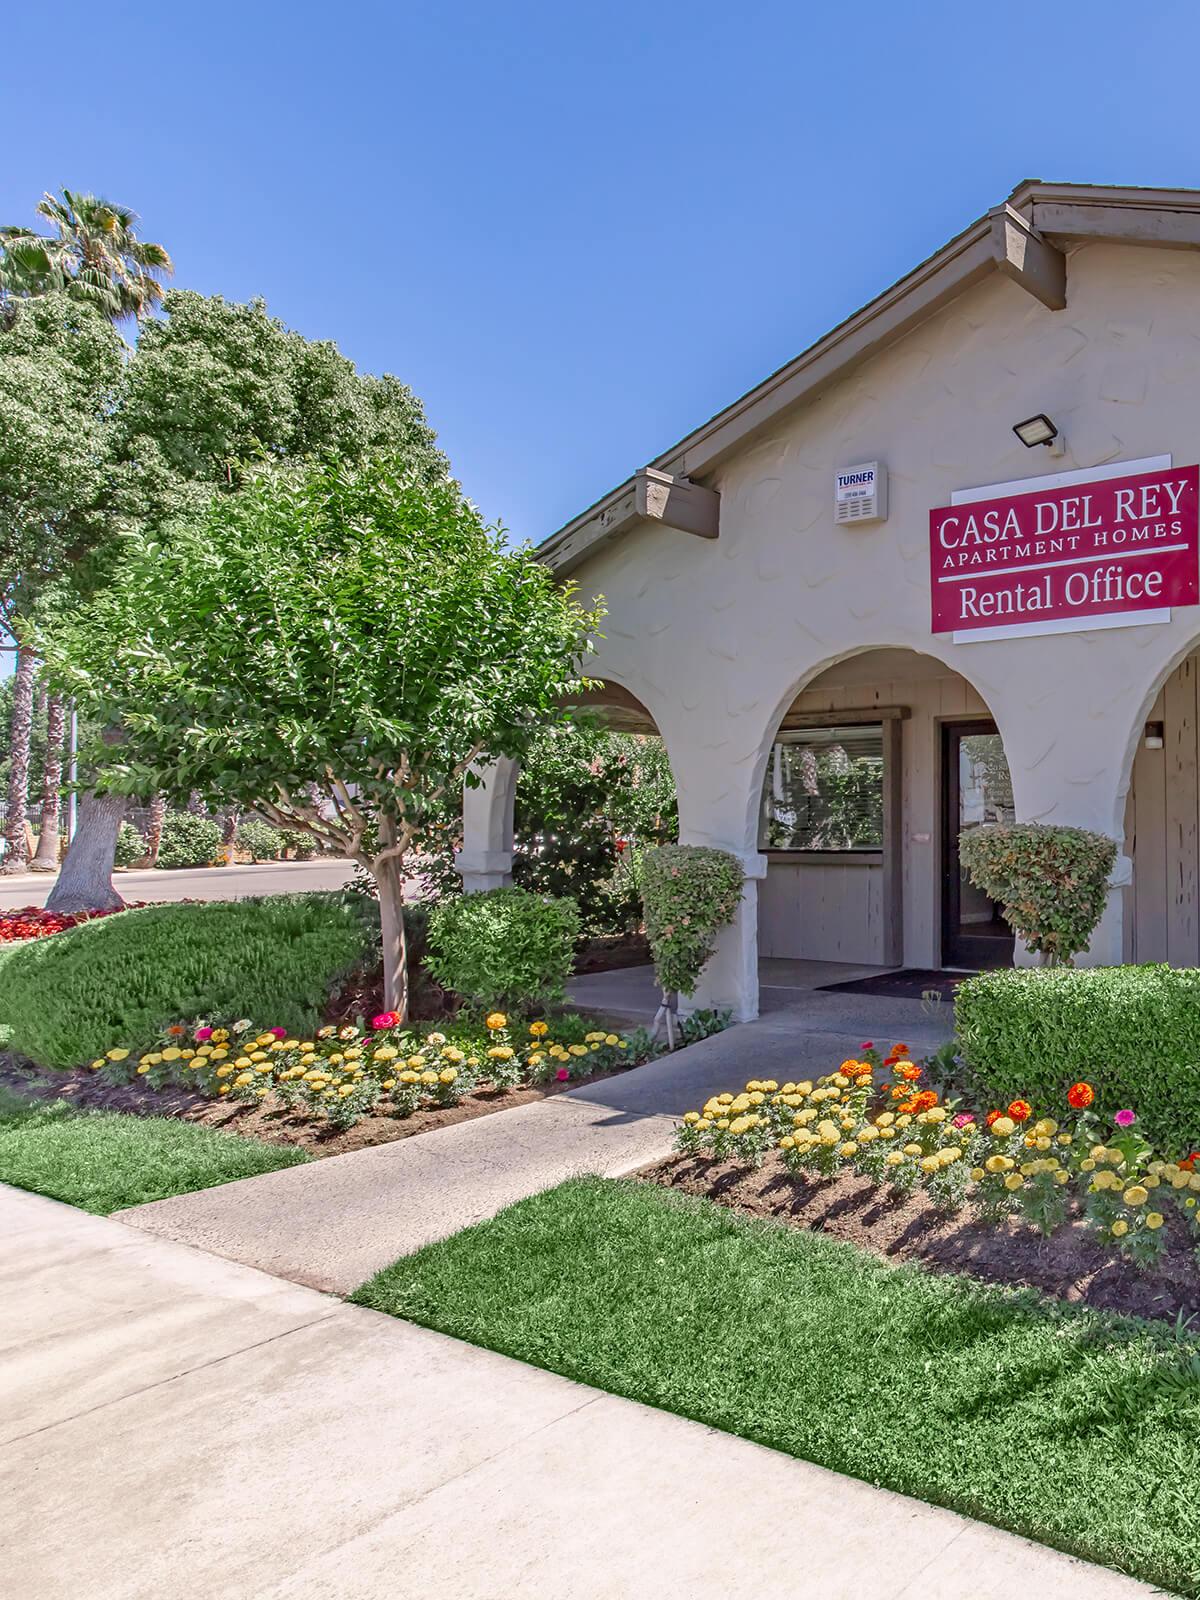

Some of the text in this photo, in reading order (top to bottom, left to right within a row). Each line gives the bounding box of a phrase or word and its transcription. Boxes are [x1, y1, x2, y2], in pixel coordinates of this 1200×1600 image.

[838, 471, 874, 486] TURNER
[939, 480, 1188, 548] CASA DEL REY
[942, 521, 1183, 569] APARTMENT HOMES
[959, 566, 1163, 619] Rental Office
